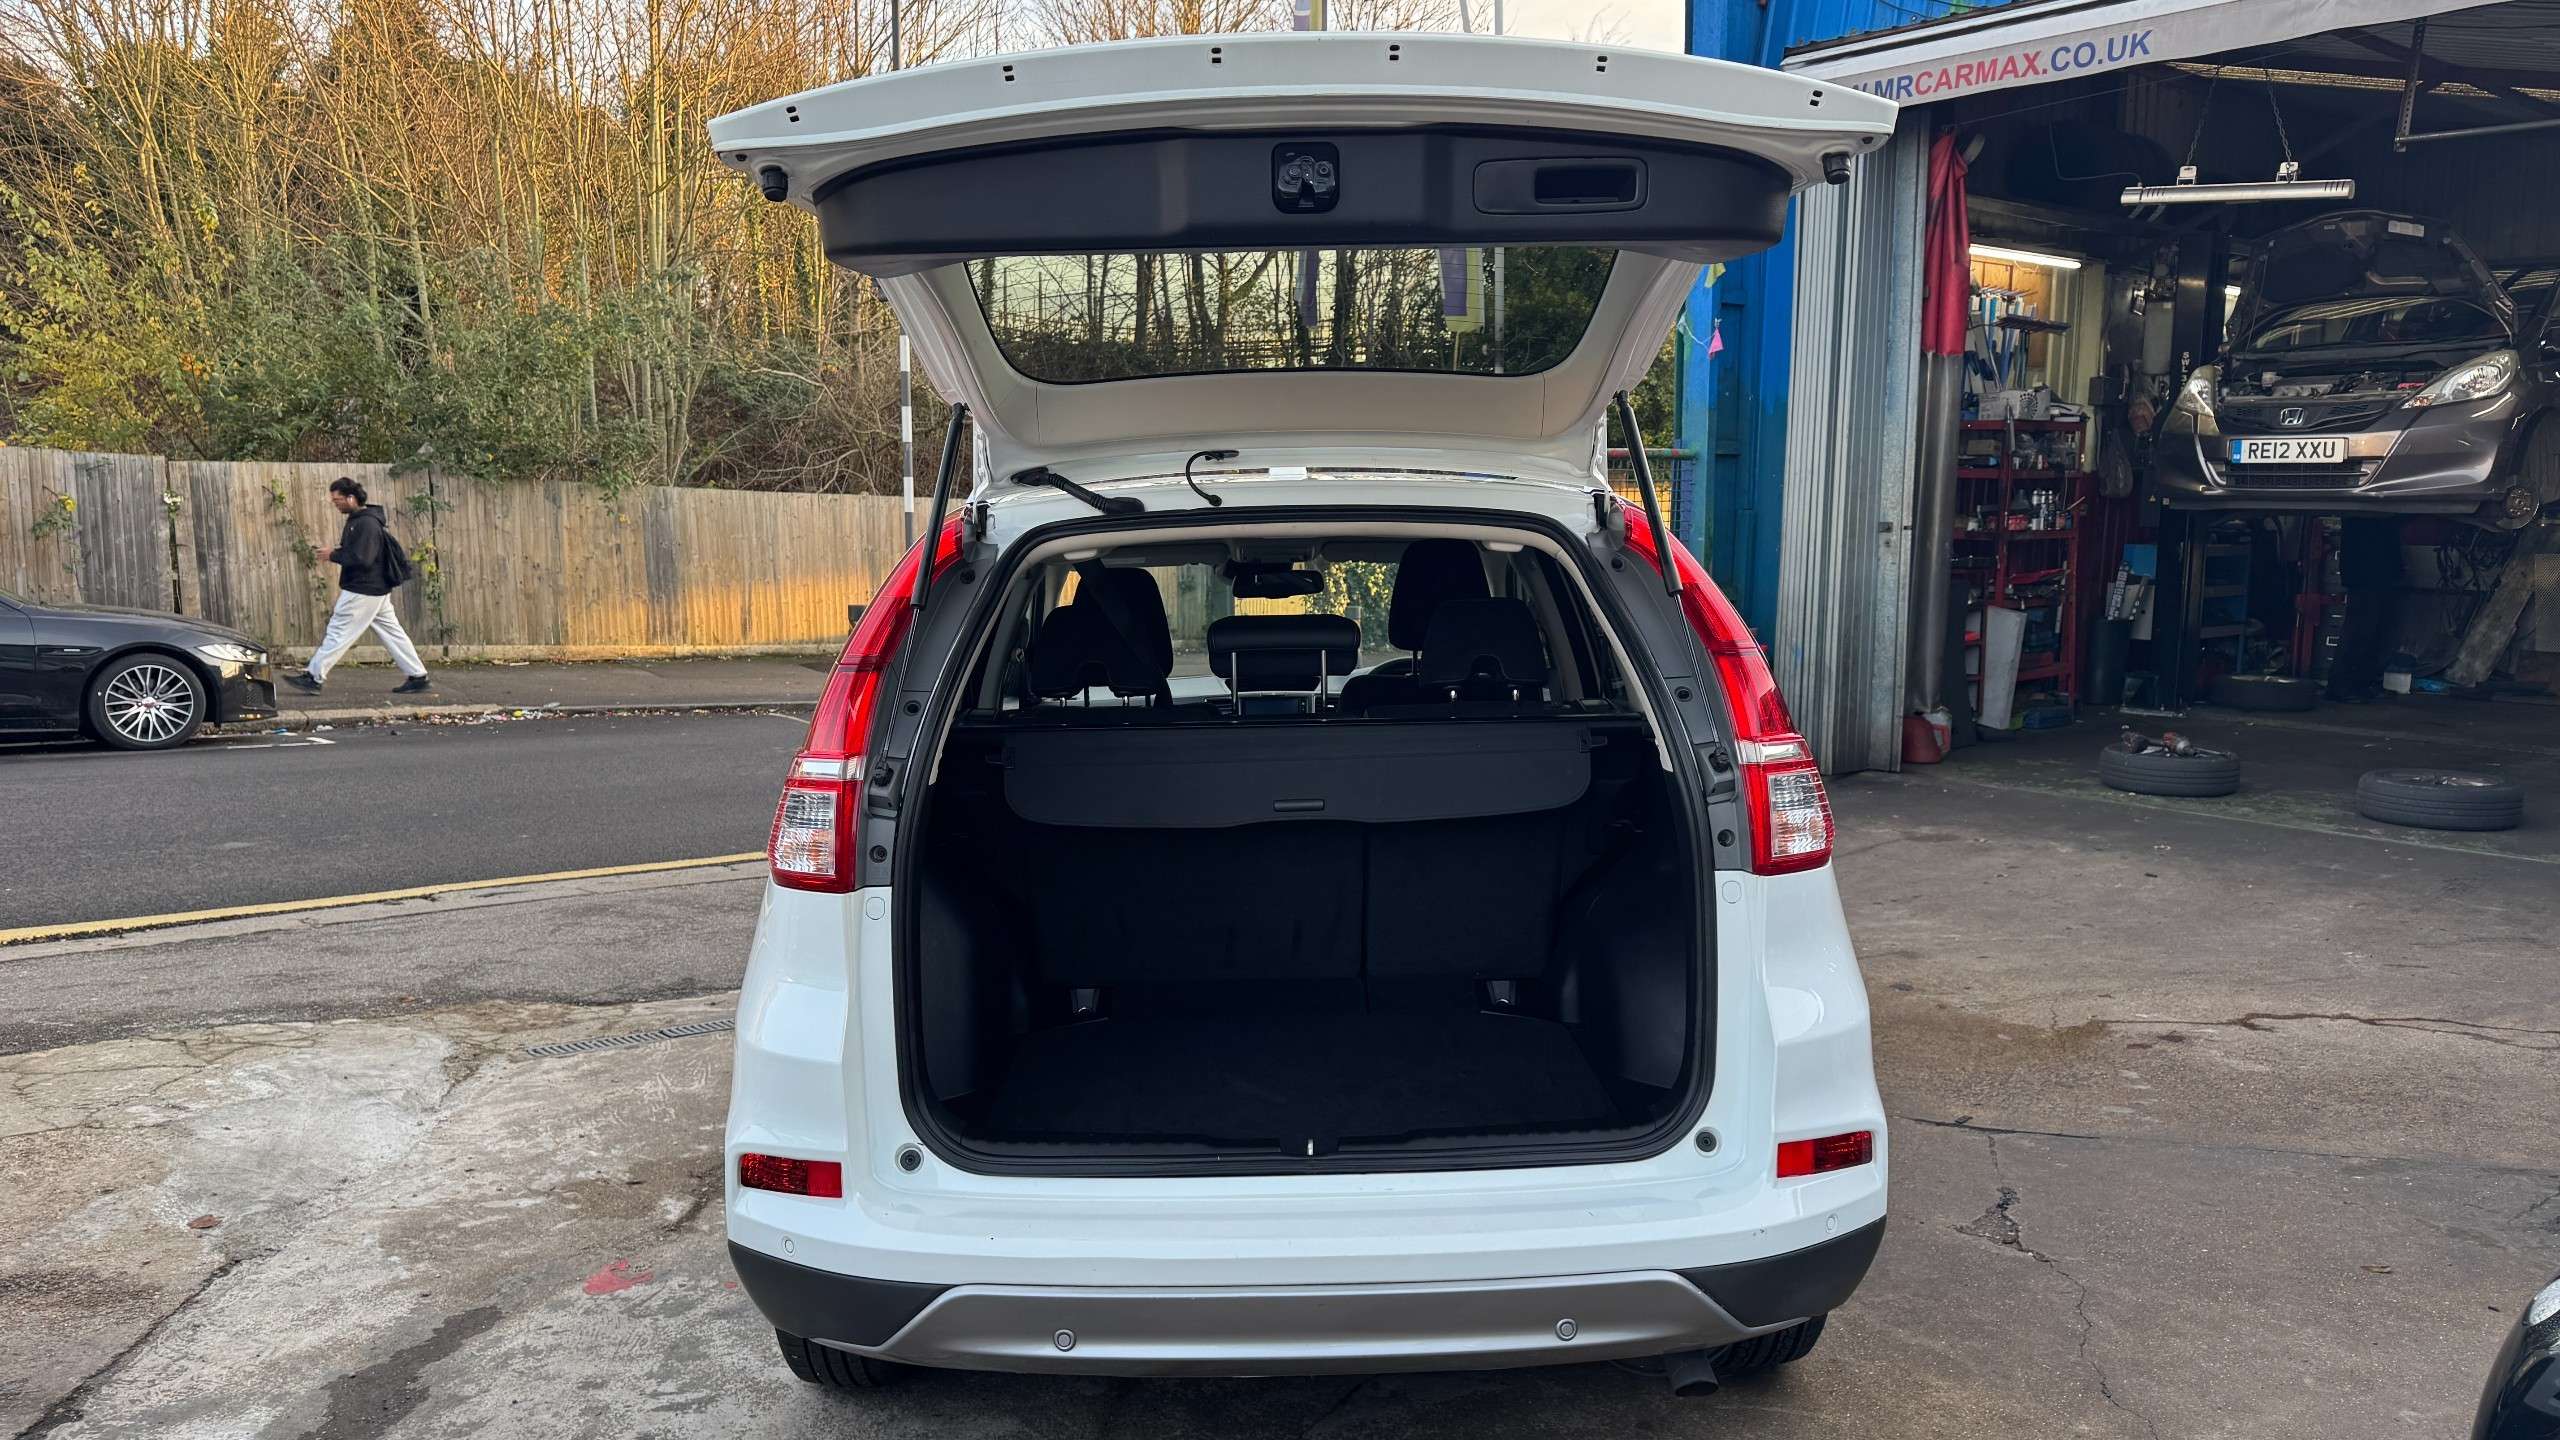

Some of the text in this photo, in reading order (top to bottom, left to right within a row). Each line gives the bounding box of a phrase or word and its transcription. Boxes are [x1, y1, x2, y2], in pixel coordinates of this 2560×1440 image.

[1852, 30, 2152, 99] MRCARMAX.CO.UK
[2248, 441, 2336, 459] RE12 XXU
